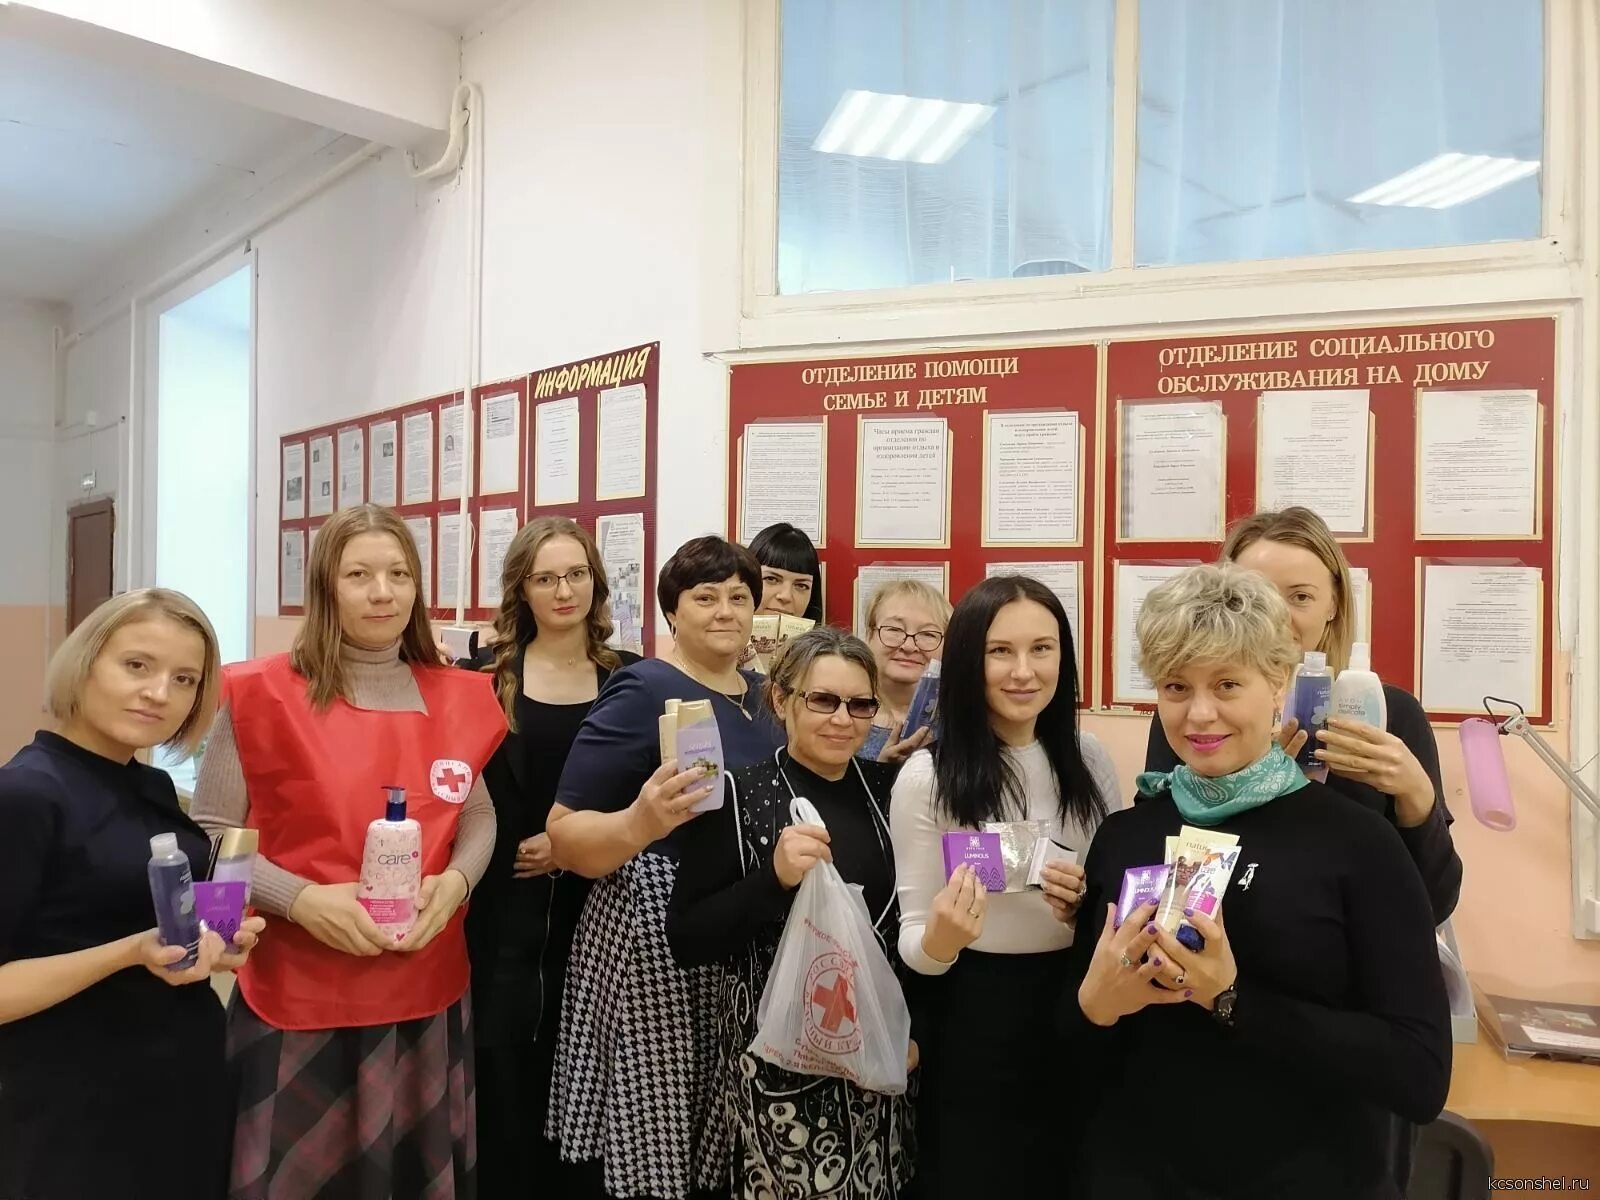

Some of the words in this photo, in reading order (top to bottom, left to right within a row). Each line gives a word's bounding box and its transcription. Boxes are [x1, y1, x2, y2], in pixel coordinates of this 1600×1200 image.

[1159, 340, 1298, 369] ОТДЕЛЕНИЕ
[1310, 329, 1496, 358] СОЦИАЛЬНОГО
[534, 346, 652, 400] ИНФОРМАЦИЯ
[801, 362, 917, 388] ОТДЕЛЕНИЕ
[924, 356, 1020, 379] ПОМОЩИ
[1157, 367, 1358, 395] ОБСЛУЖИВАНИЯ
[1366, 365, 1404, 385] НА
[1413, 360, 1491, 384] ДОМУ
[823, 391, 887, 411] СЕМЬЕ
[895, 390, 909, 408] И
[916, 386, 988, 410] ДЕТЯМ
[377, 852, 411, 866] care
